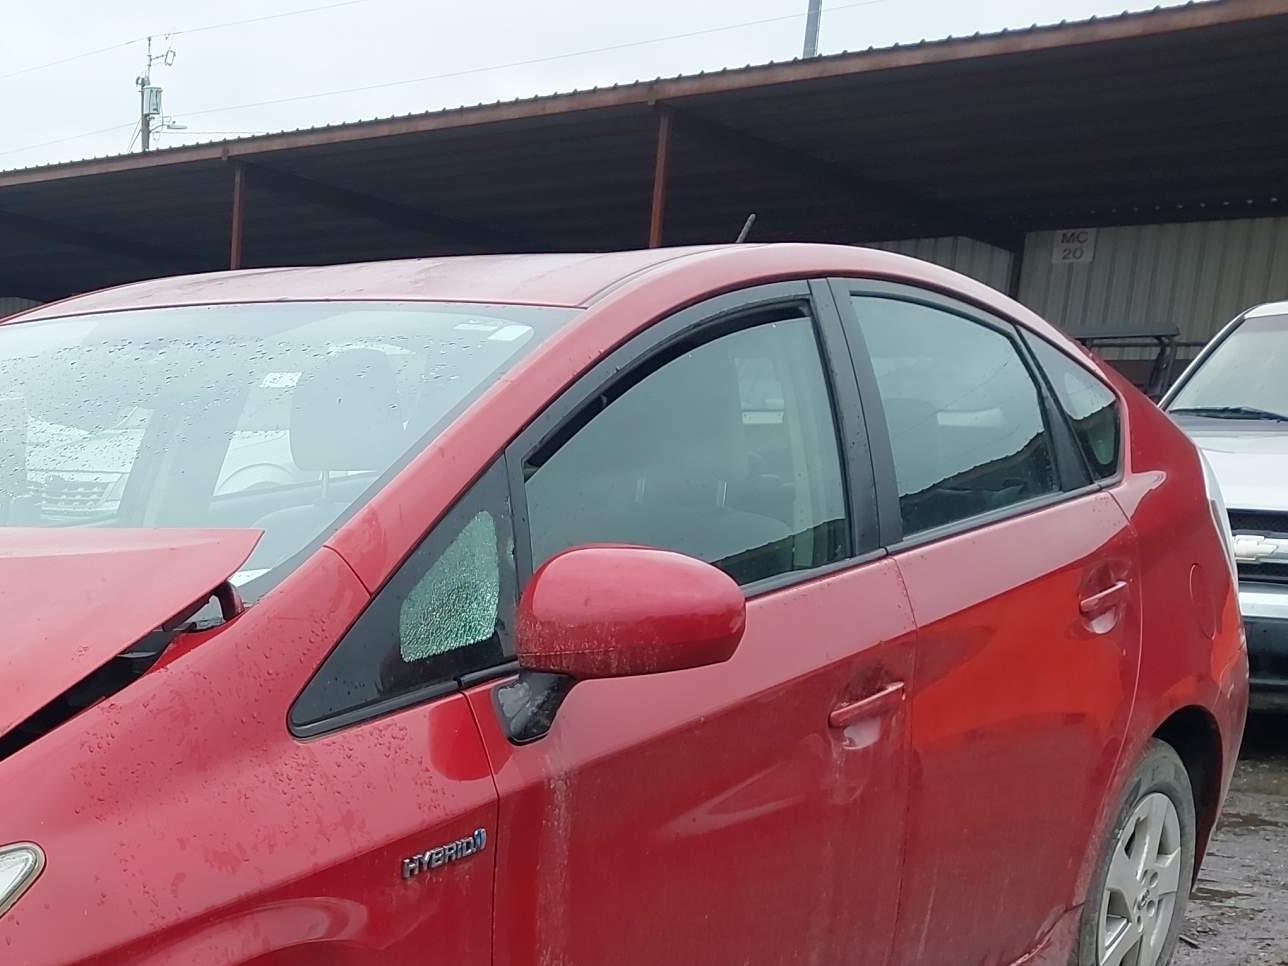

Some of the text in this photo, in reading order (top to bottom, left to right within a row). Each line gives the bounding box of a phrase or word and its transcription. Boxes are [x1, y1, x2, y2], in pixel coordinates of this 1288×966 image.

[1061, 231, 1089, 244] MC
[1062, 248, 1084, 260] 20
[401, 836, 476, 879] HYBRID
